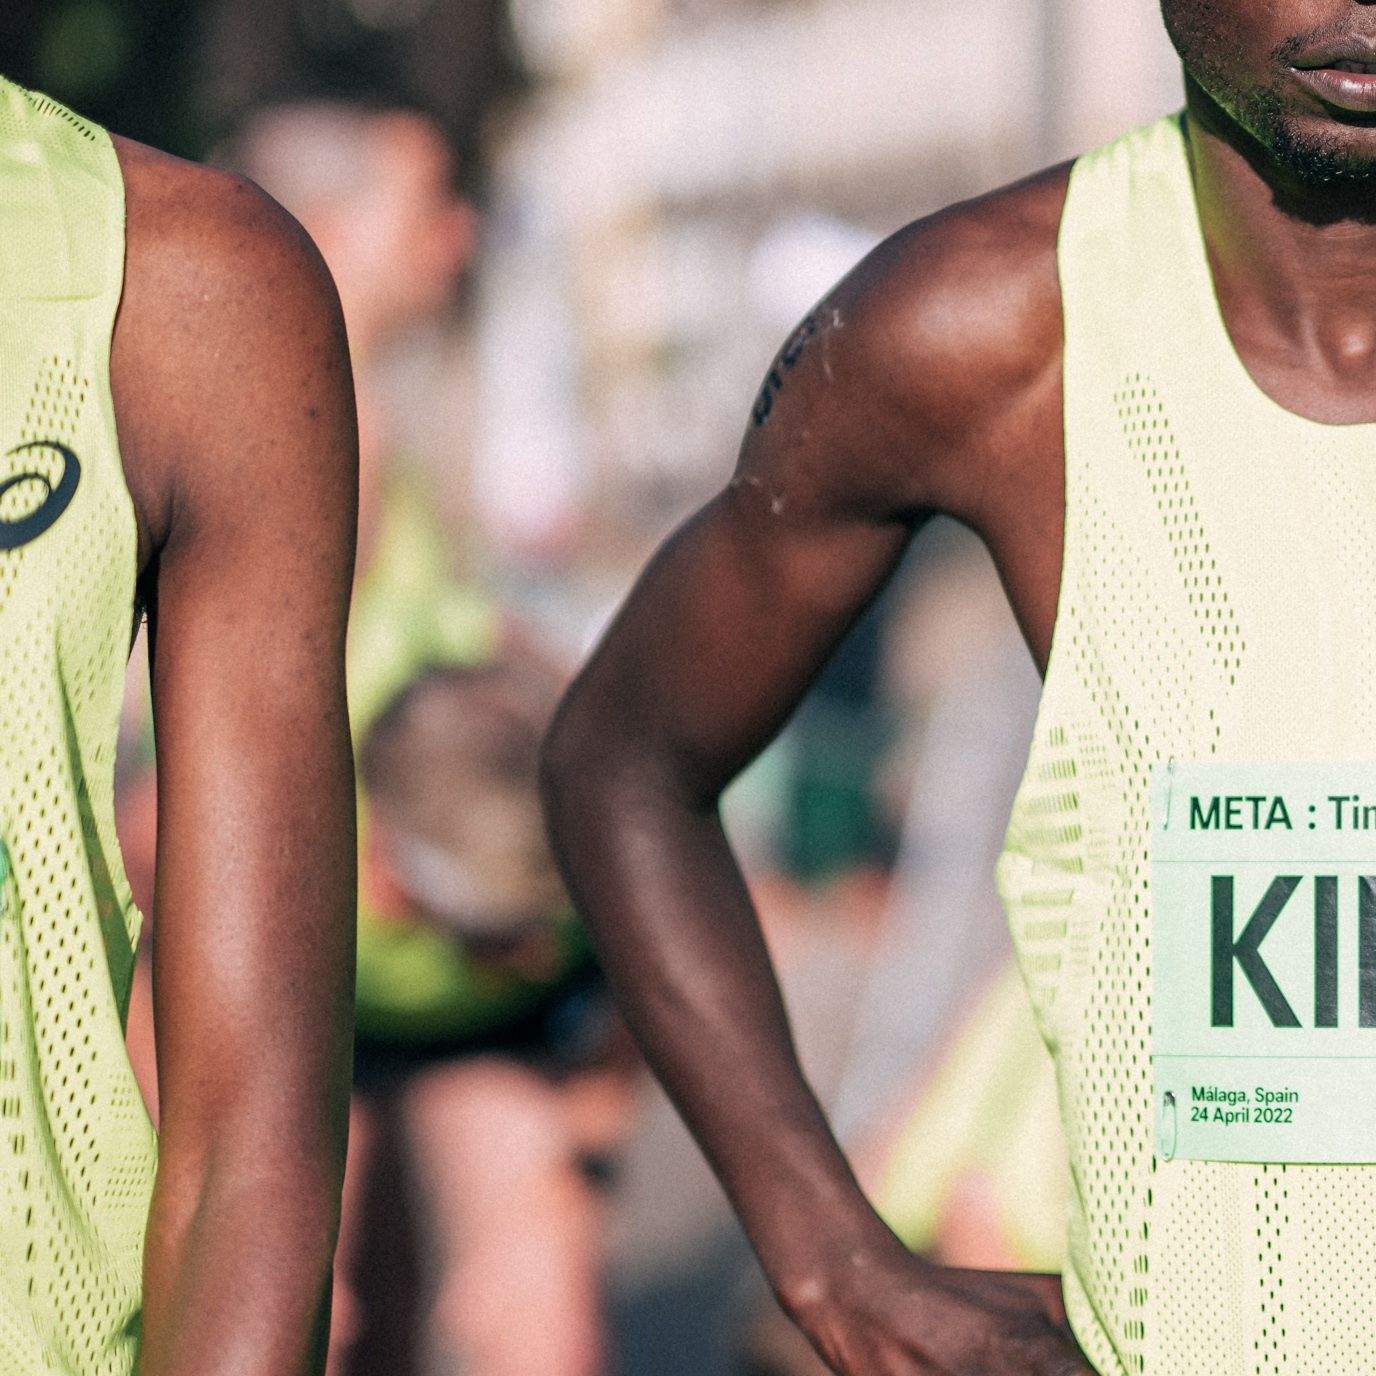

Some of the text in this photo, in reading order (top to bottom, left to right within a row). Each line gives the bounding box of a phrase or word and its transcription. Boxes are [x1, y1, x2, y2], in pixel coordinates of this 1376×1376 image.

[1189, 795, 1293, 830] META
[1191, 1086, 1299, 1105] Málaga, Spain
[1190, 1107, 1293, 1126] 24 April 2022
